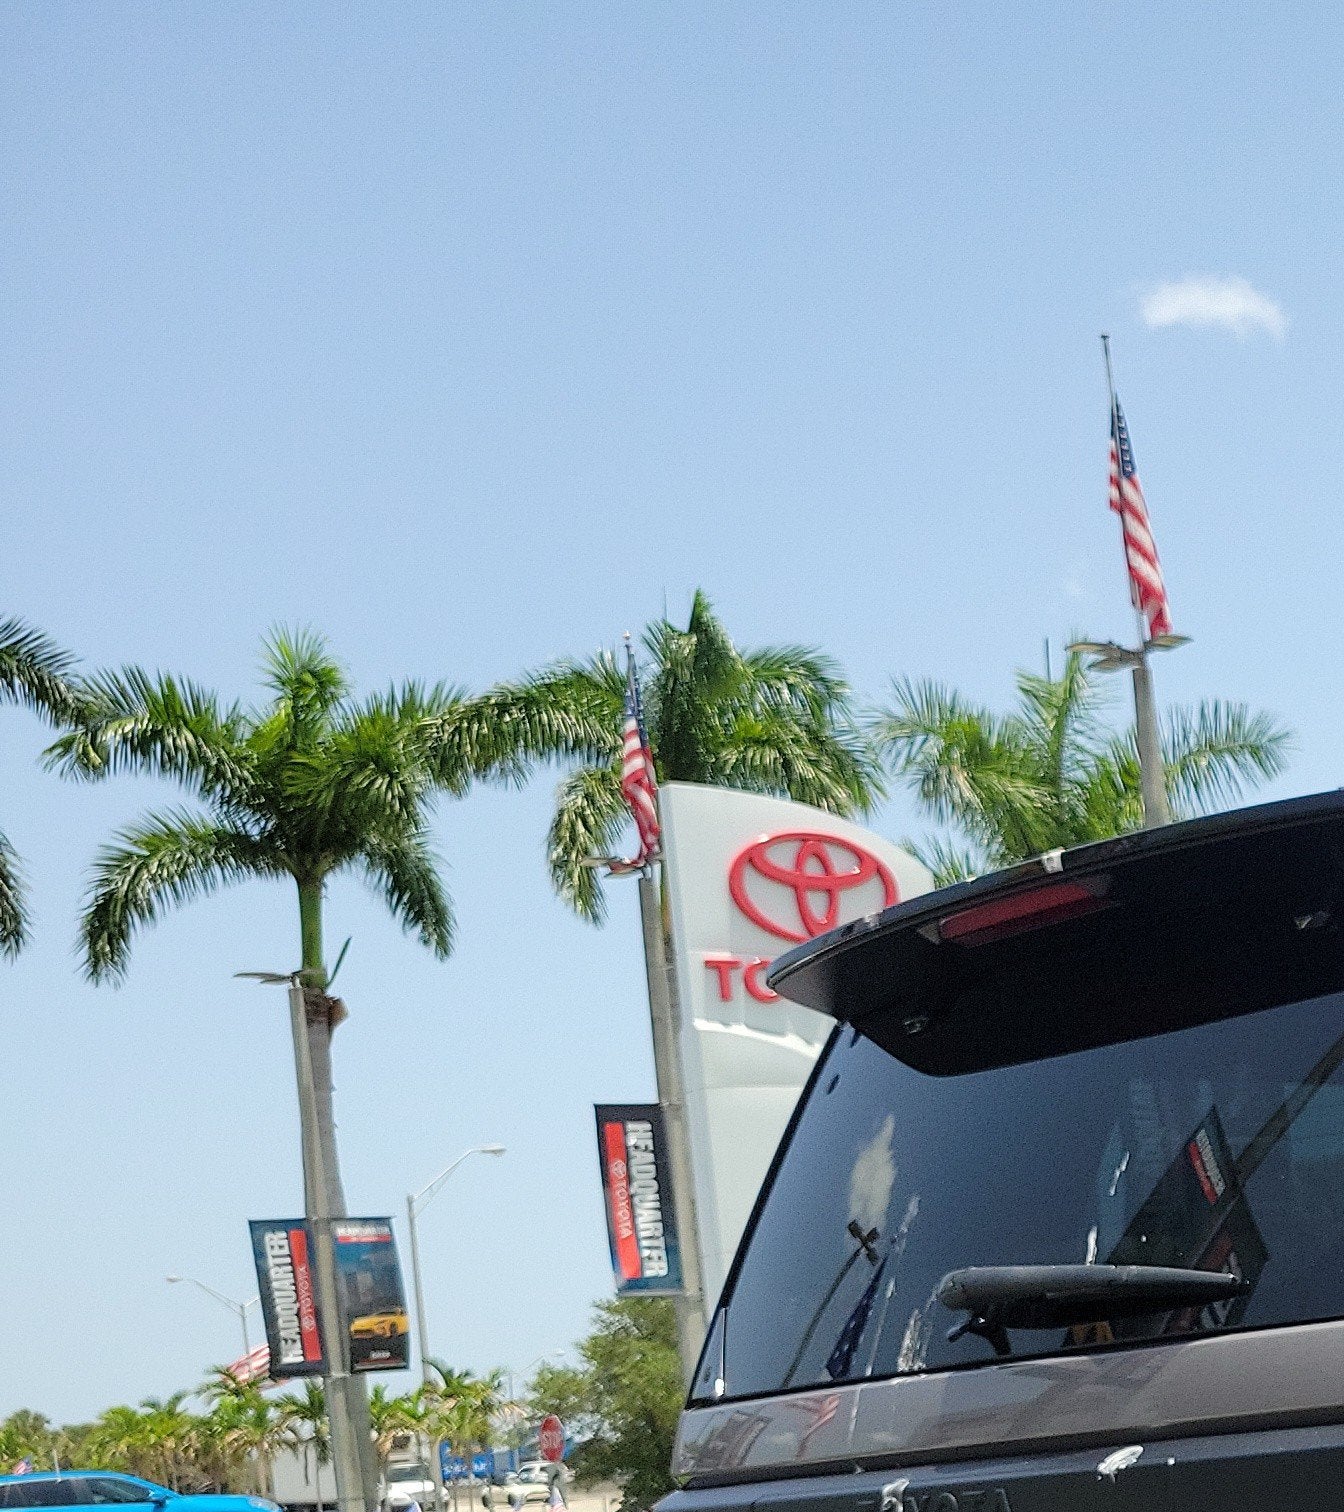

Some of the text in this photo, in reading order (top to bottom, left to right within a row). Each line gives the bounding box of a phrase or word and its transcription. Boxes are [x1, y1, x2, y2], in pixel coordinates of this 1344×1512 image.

[615, 1180, 632, 1239] TOYOTA
[625, 1121, 668, 1278] HEADQUARTER
[264, 1230, 304, 1364] HEADQUARTER
[297, 1266, 315, 1316] TOYOTA
